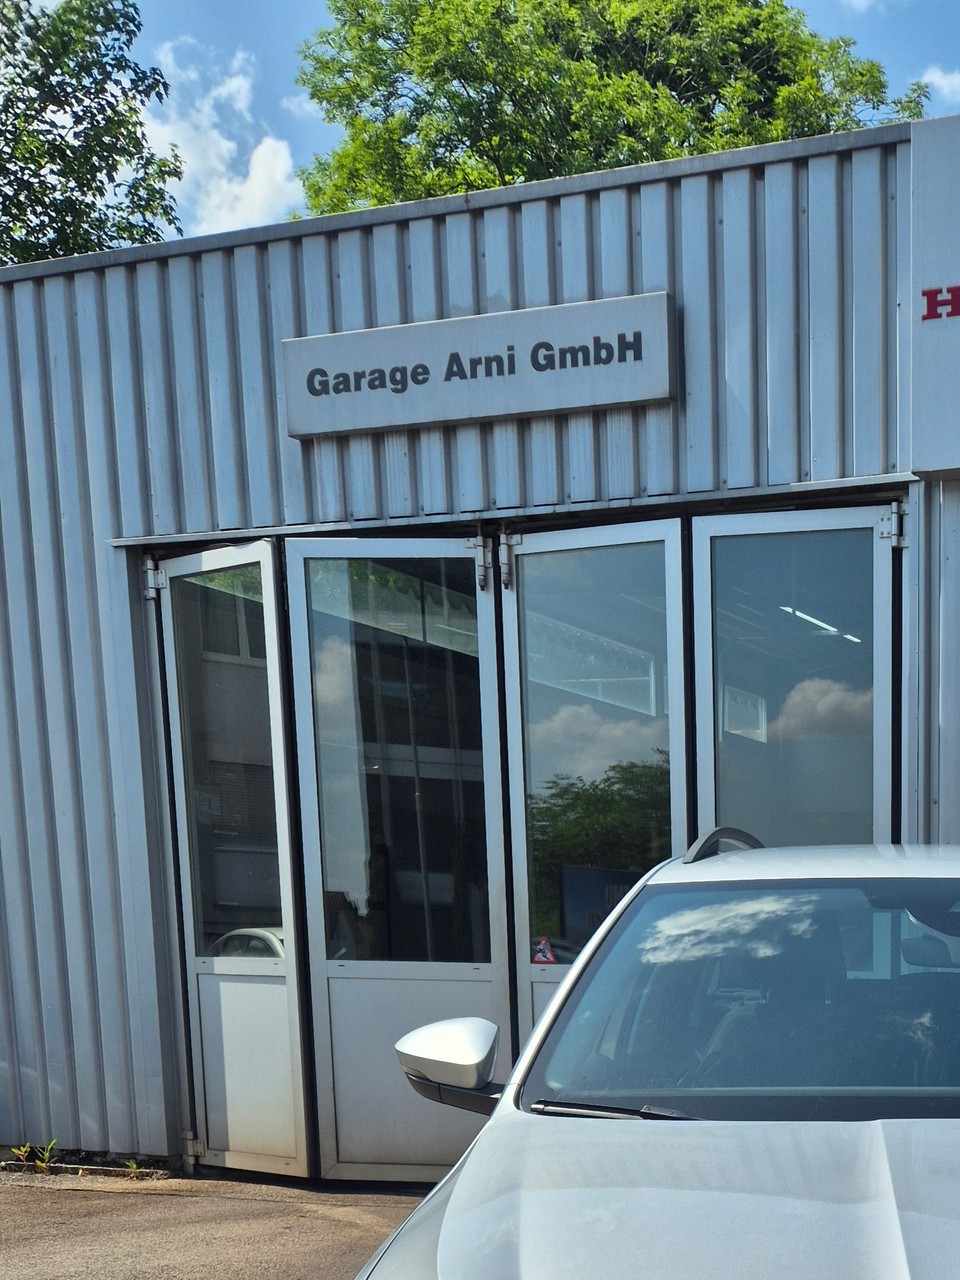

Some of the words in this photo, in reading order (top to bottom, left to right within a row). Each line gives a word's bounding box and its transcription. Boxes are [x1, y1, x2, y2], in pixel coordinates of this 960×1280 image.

[306, 363, 430, 397] Garage
[444, 345, 517, 382] Arni
[530, 330, 643, 372] GmbH
